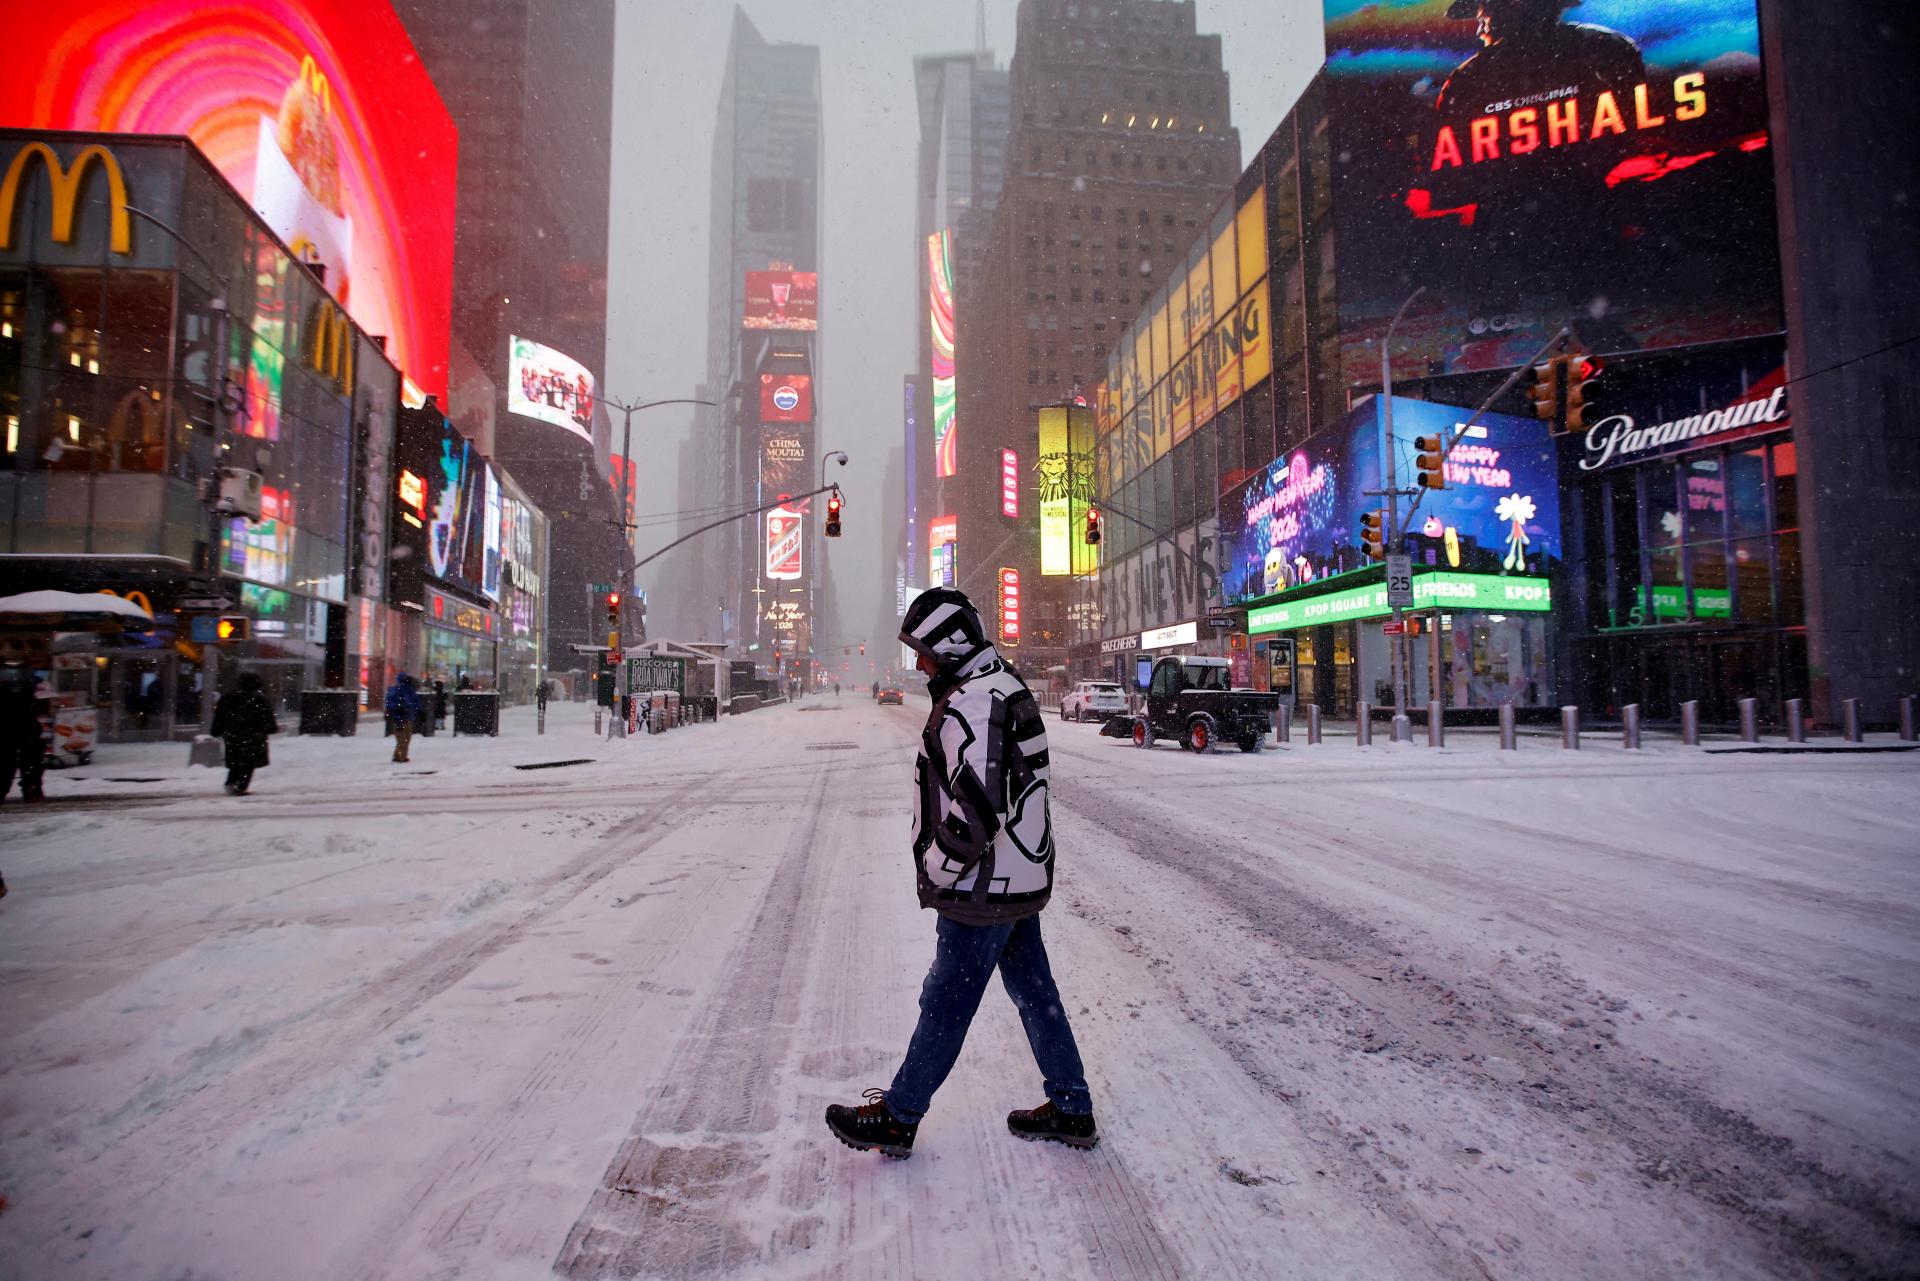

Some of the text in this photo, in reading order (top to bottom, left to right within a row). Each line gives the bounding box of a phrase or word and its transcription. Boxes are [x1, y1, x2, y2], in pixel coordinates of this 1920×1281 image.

[1485, 99, 1511, 113] CBS
[1180, 284, 1211, 338] THE
[1158, 354, 1199, 436] LION
[1201, 298, 1260, 400] KING
[1580, 386, 1786, 471] Paramount
[766, 448, 805, 457] MOUTAI
[769, 440, 801, 448] CHINA
[1471, 466, 1511, 487] YEAR
[1247, 498, 1275, 525] HAPPY
[1275, 484, 1297, 511] NEW
[1297, 465, 1325, 501] YEAR
[1269, 512, 1300, 546] 2026
[512, 559, 525, 590] OLD
[1134, 537, 1216, 621] NEWS
[1390, 576, 1410, 591] 25
[1304, 603, 1329, 617] KPOP
[1330, 594, 1370, 614] SQUARE
[1376, 592, 1388, 605] BY
[1423, 583, 1477, 598] FRIENDS
[1505, 586, 1543, 600] KPOP
[785, 611, 806, 621] Year
[1263, 610, 1289, 624] FRIENDS
[1101, 634, 1138, 653] SKECHERS
